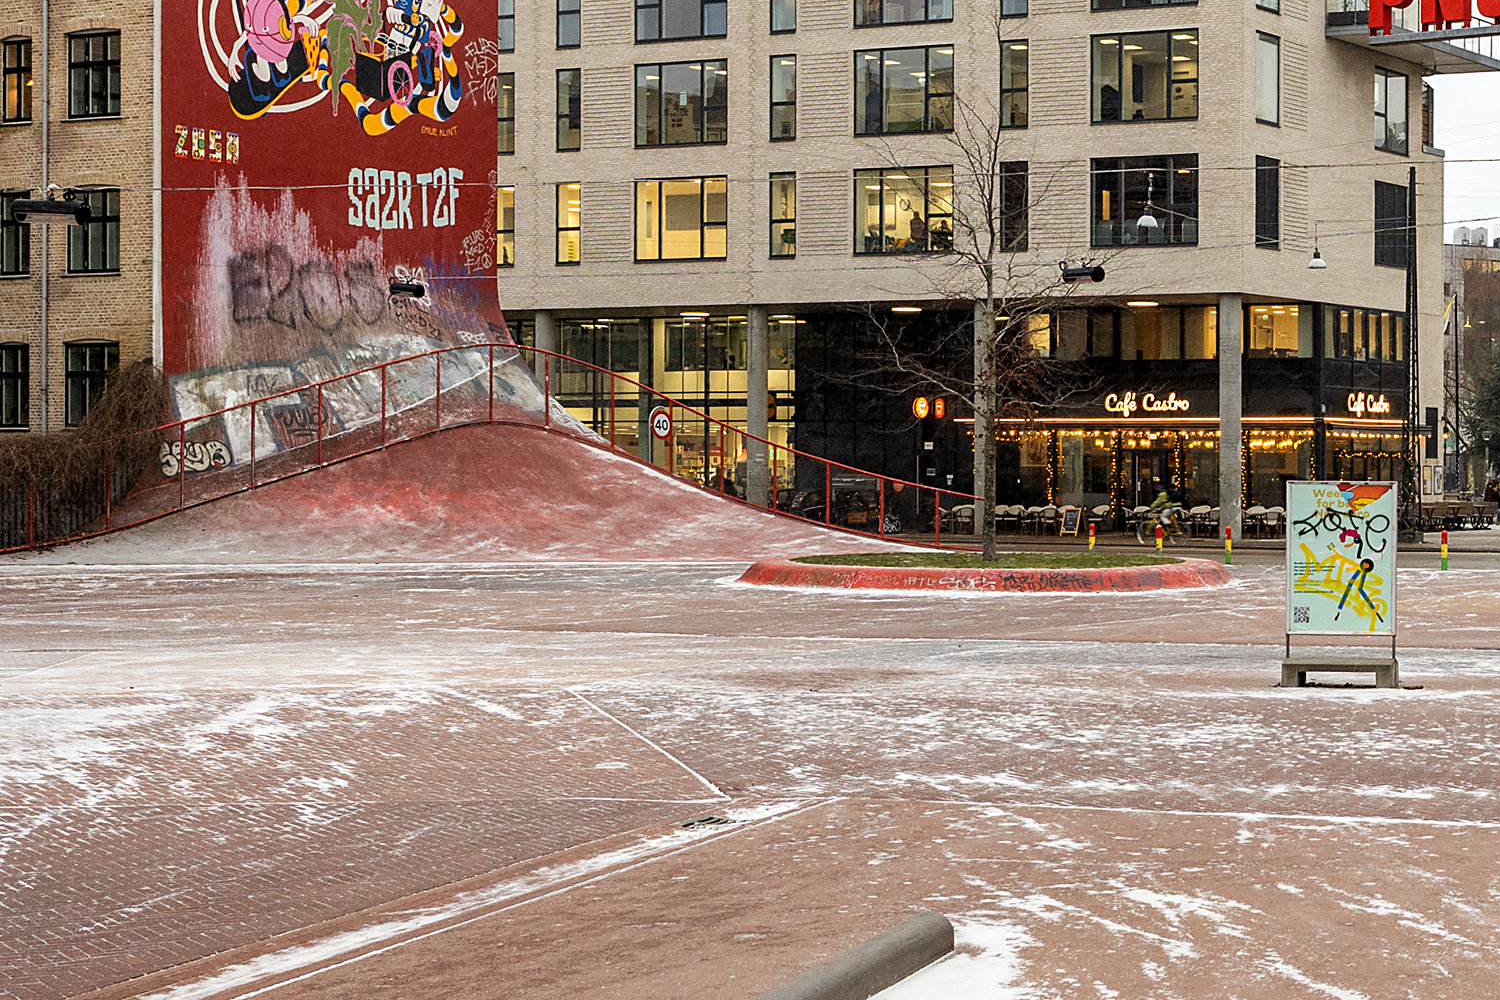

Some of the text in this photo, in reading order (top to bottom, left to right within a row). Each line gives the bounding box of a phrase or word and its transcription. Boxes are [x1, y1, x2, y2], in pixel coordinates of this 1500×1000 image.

[1105, 391, 1190, 417] Café Castro
[654, 420, 668, 430] 40
[1316, 500, 1335, 508] for
